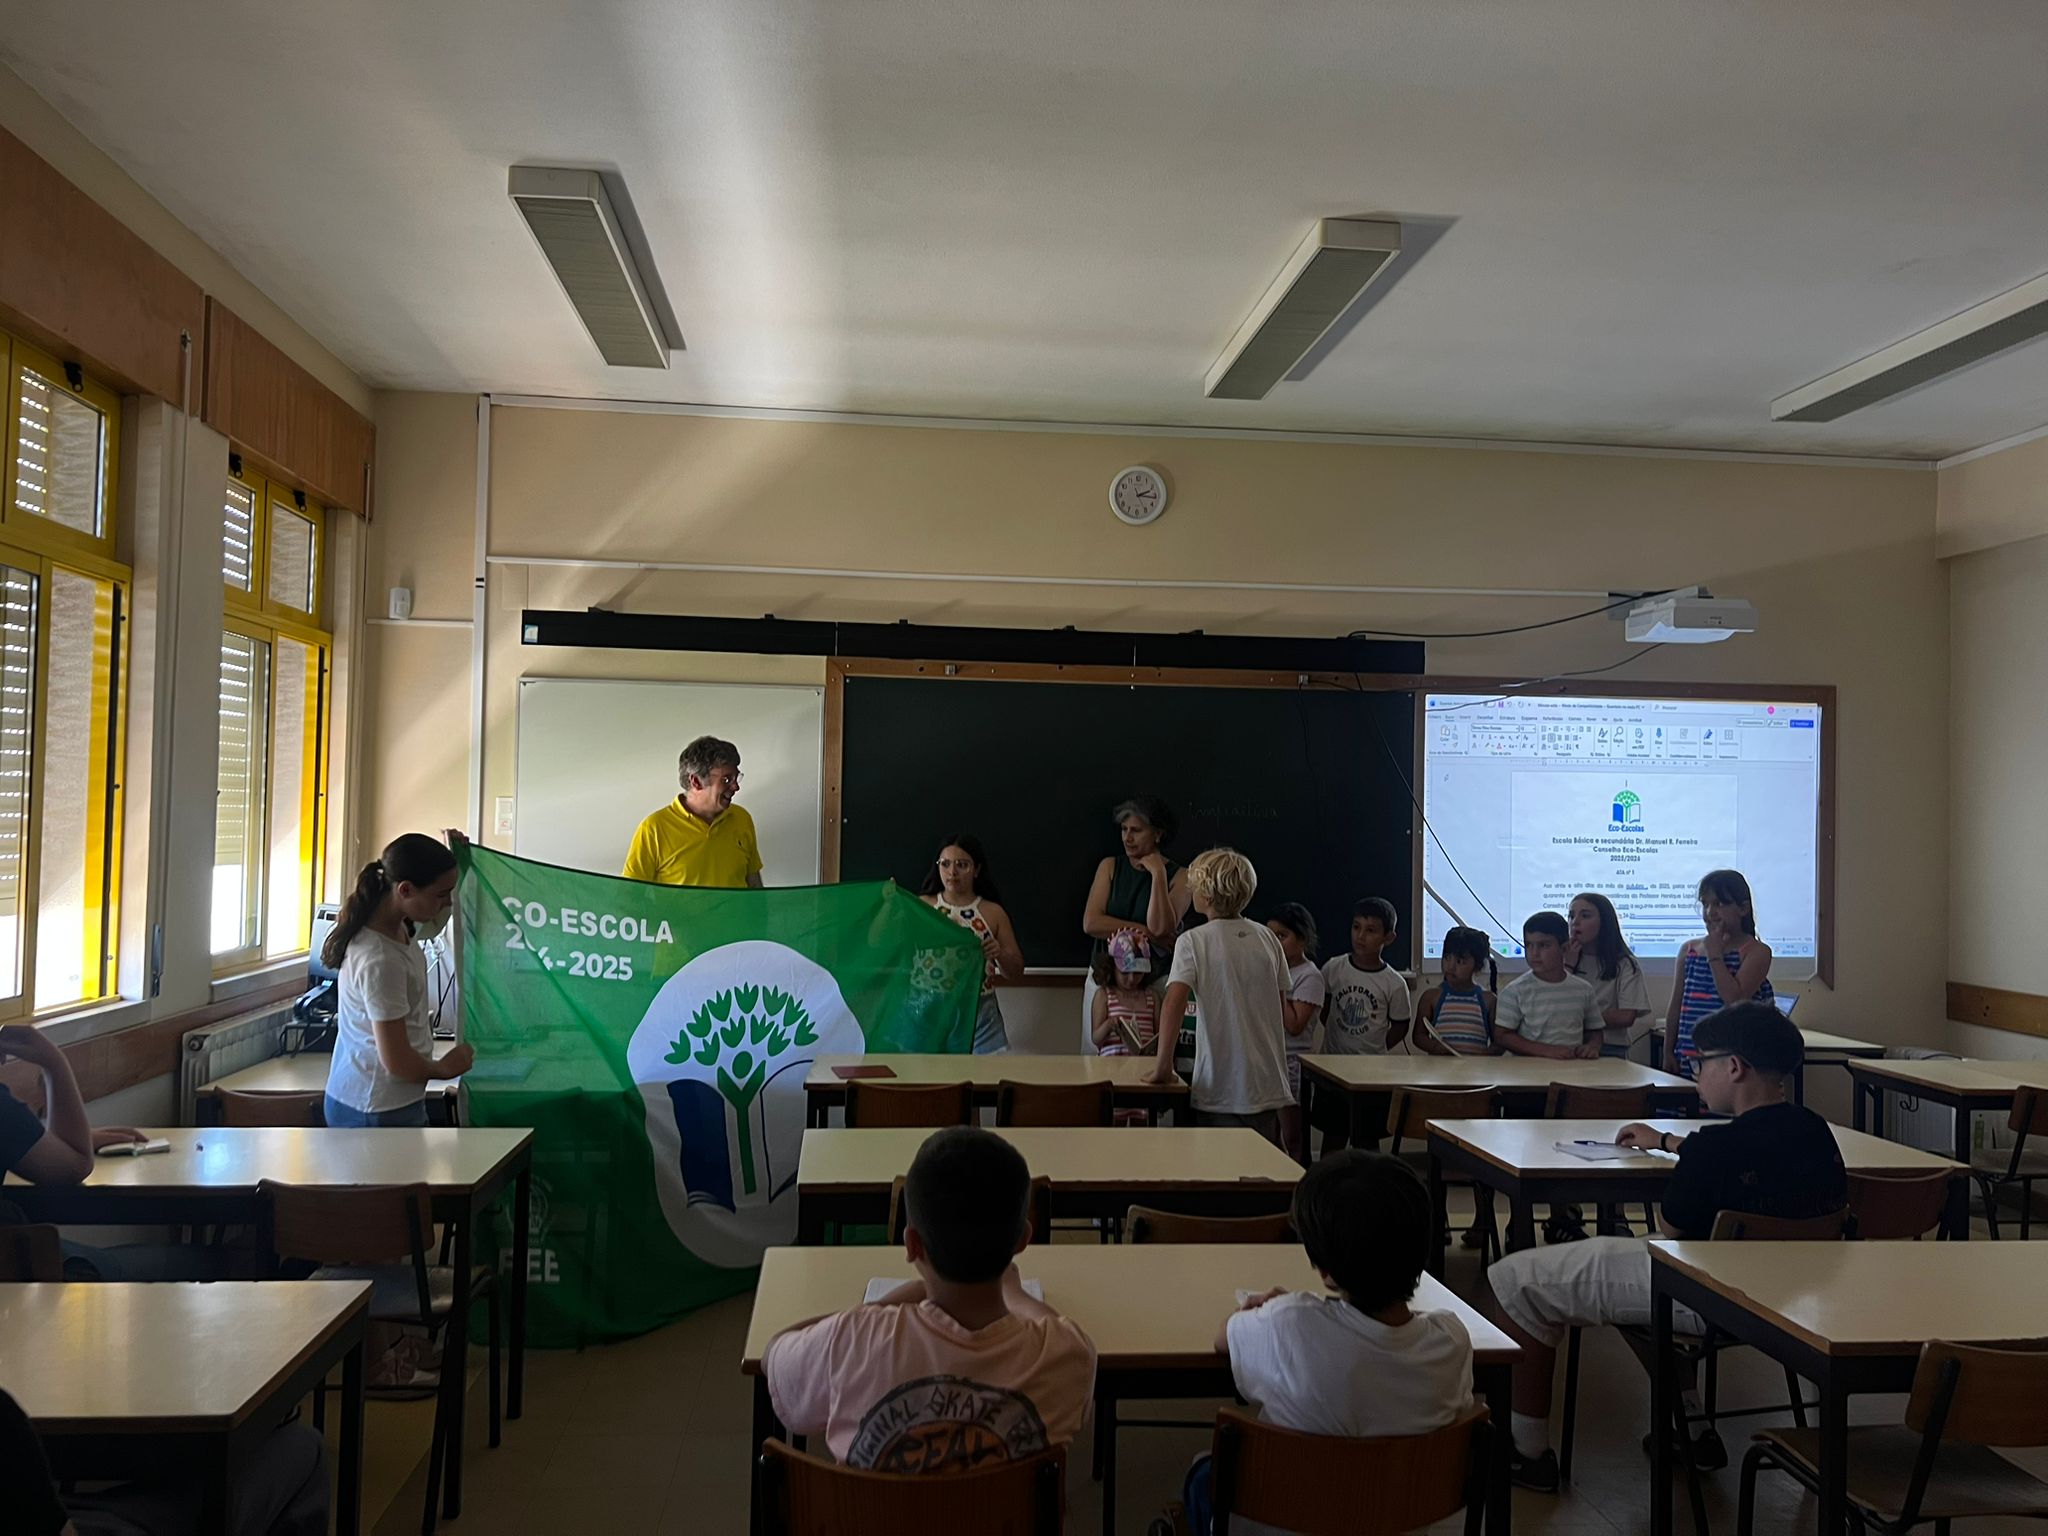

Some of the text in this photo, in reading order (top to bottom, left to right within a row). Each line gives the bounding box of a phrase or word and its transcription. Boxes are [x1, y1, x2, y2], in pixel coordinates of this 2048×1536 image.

[1608, 824, 1645, 833] Eco-Escolas
[1600, 837, 1635, 845] secundária
[1350, 1025, 1370, 1036] CLUB
[926, 1385, 1004, 1426] SKATE
